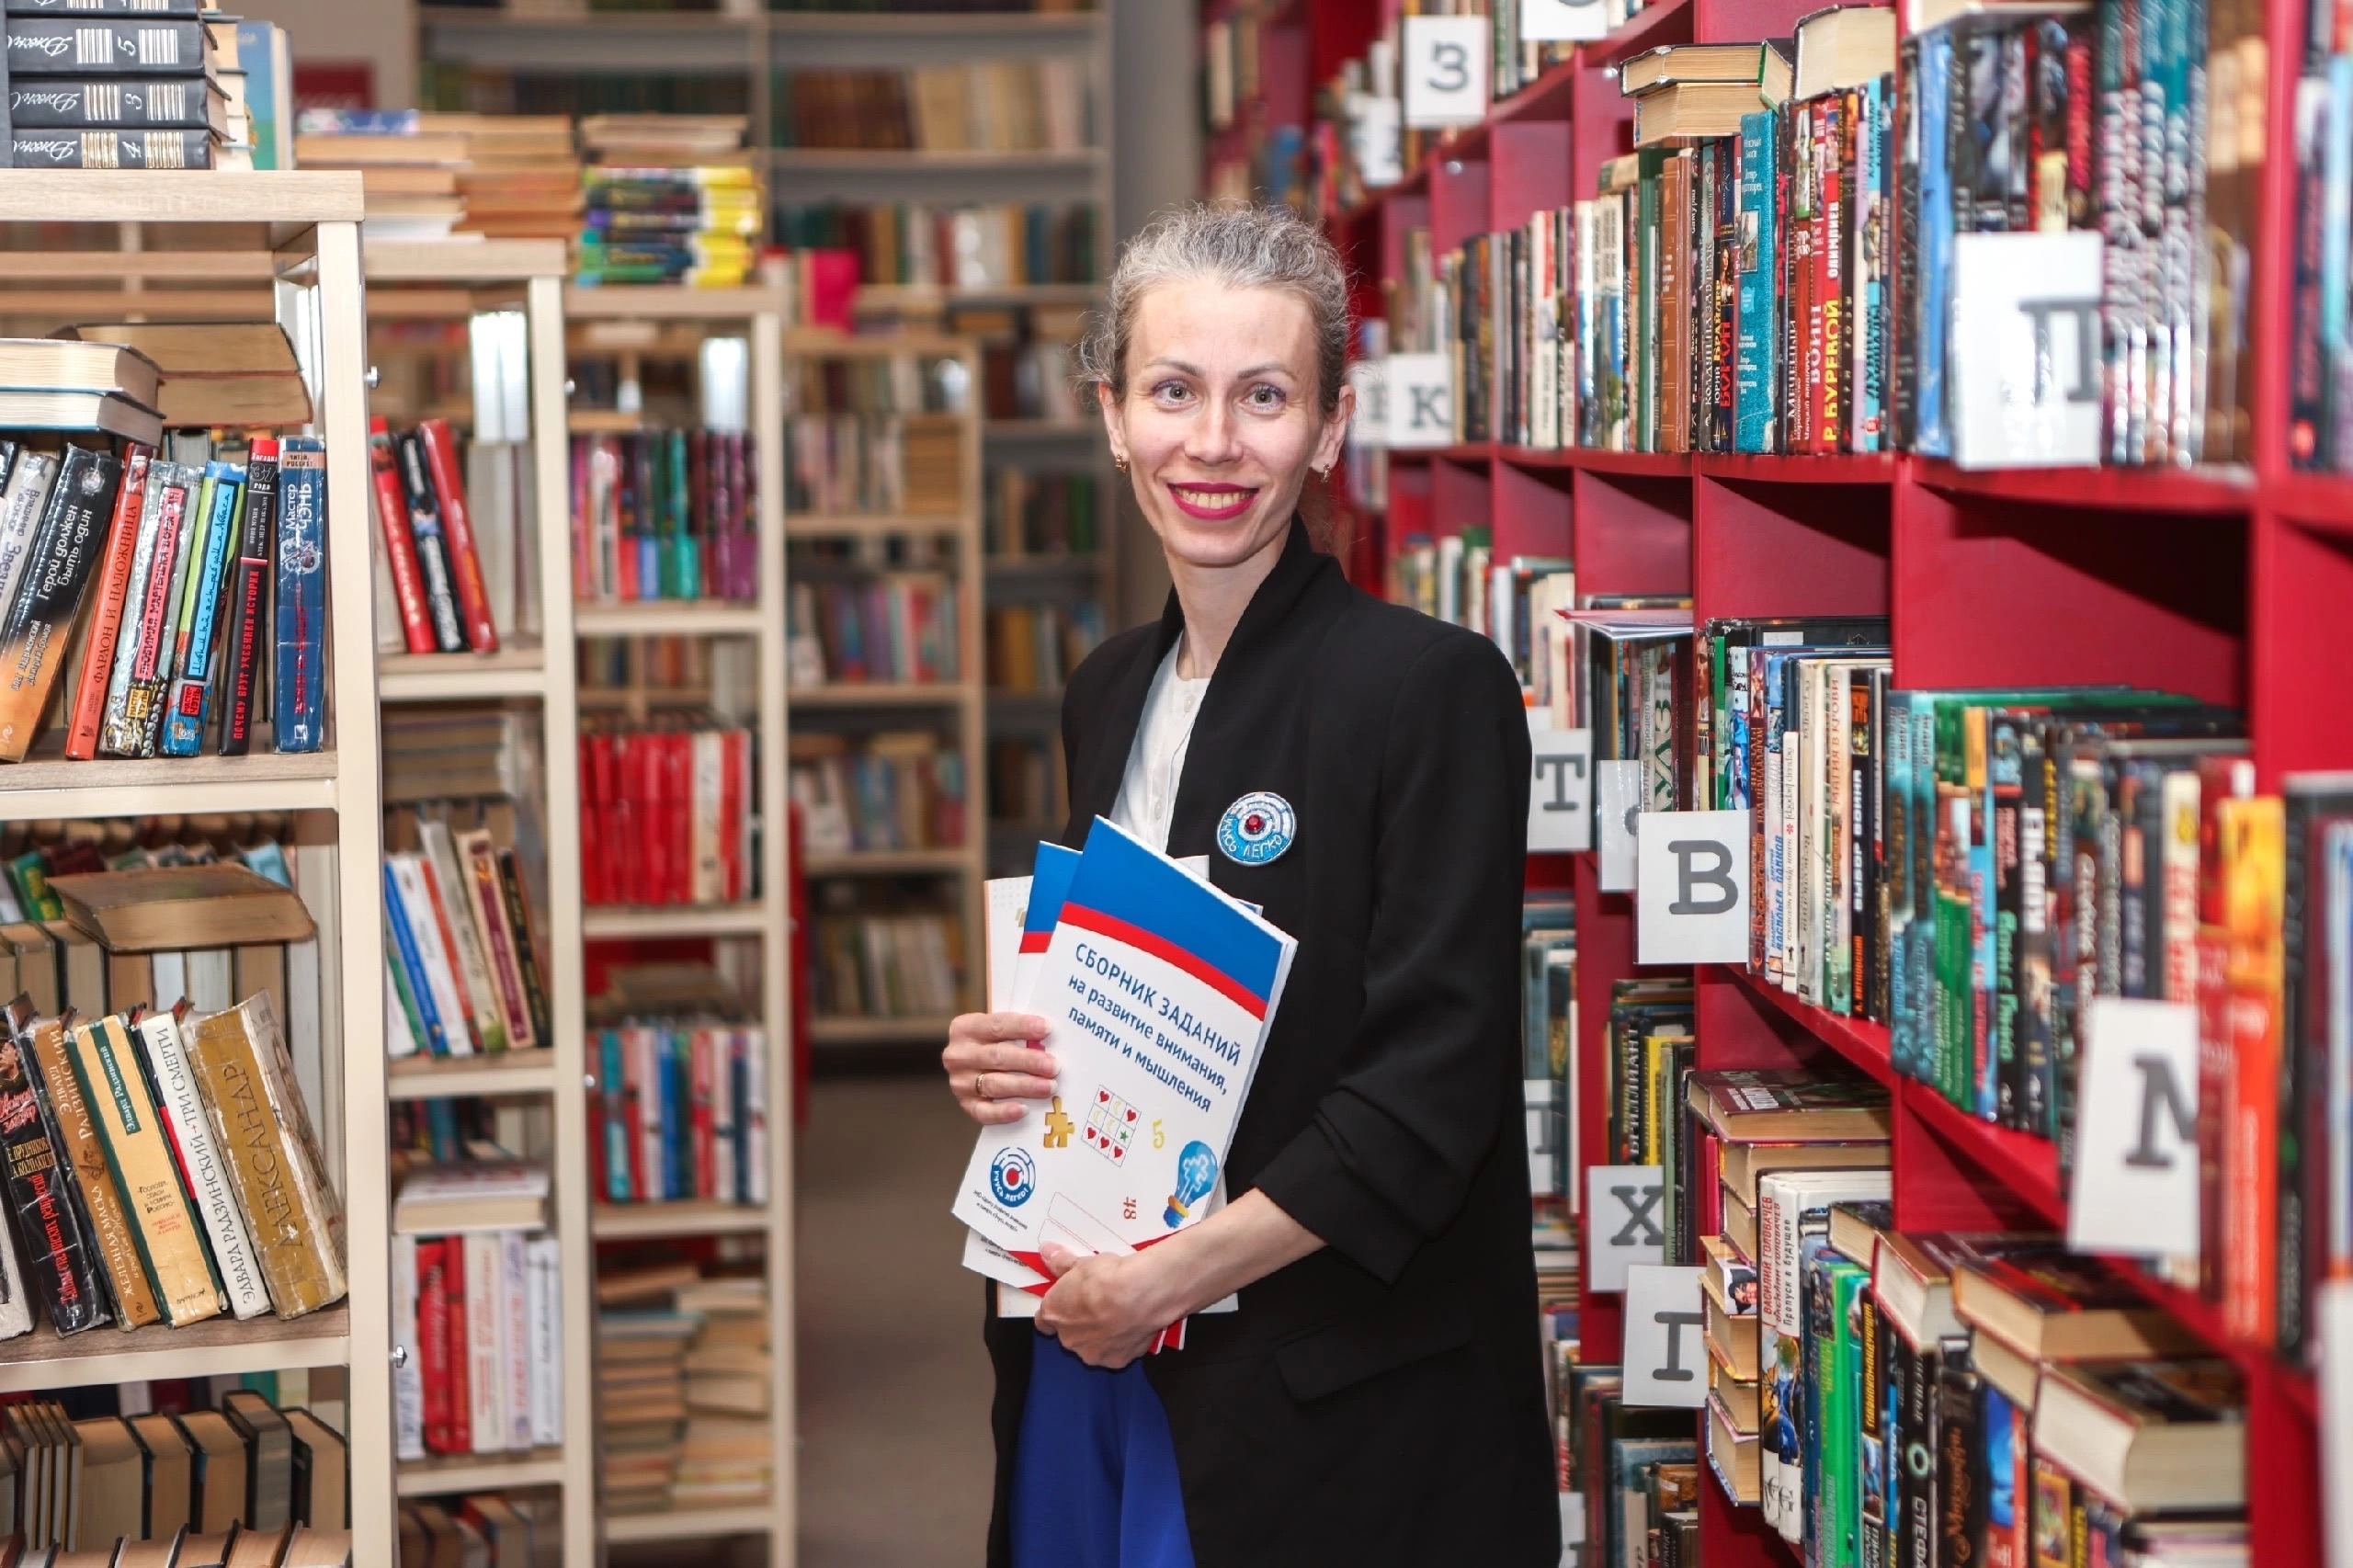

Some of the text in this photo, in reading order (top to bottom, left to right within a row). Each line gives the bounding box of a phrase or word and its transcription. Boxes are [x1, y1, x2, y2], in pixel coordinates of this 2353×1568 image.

[1824, 300, 1839, 418] БУРЕВОЙ
[253, 483, 272, 493] года
[286, 483, 298, 530] Мастер
[298, 483, 313, 530] ЧЭНЬ
[36, 504, 79, 600] Герой должен
[58, 508, 94, 588] быть один
[94, 627, 113, 685] ФАРАОН
[110, 505, 138, 603] НАЛОЖНИЦА
[233, 570, 260, 739] ПОЧЕМУ ВРУТ УЧЕБНИКИ ИСТОРИИ
[1830, 679, 1839, 732] КРОВИ
[1535, 753, 1586, 812] Т
[1831, 750, 1840, 805] МАГИЯ
[1667, 840, 1740, 915] В
[1852, 769, 1863, 912] ВЫБОР ВОИНА
[1068, 975, 1228, 1095] на развитие внимания,
[1075, 943, 1241, 1066] СБОРНИК ЗАДАНИЙ
[49, 1030, 94, 1140] РАДЗИНСКИЙ
[49, 1066, 73, 1115] ЭДВАРД
[101, 1045, 136, 1132] Эдвард Радзинский
[1068, 1007, 1211, 1112] памяти и мышления
[157, 1027, 256, 1304] ЭДВАРД РАДЗИНСКИЙ ТРИ СМЕРТИ
[223, 1064, 303, 1247] АЛЕКСАНДР
[1152, 1119, 1165, 1149] 5
[91, 1186, 134, 1297] ЖЕЛЕЗНАЯ МАСКА
[1610, 1185, 1664, 1246] Х
[1761, 1197, 1773, 1315] ВАСИЛИЙ ГОЛОВАЧЕВ
[1783, 1219, 1794, 1266] будущее
[1782, 1280, 1794, 1326] Пропуск
